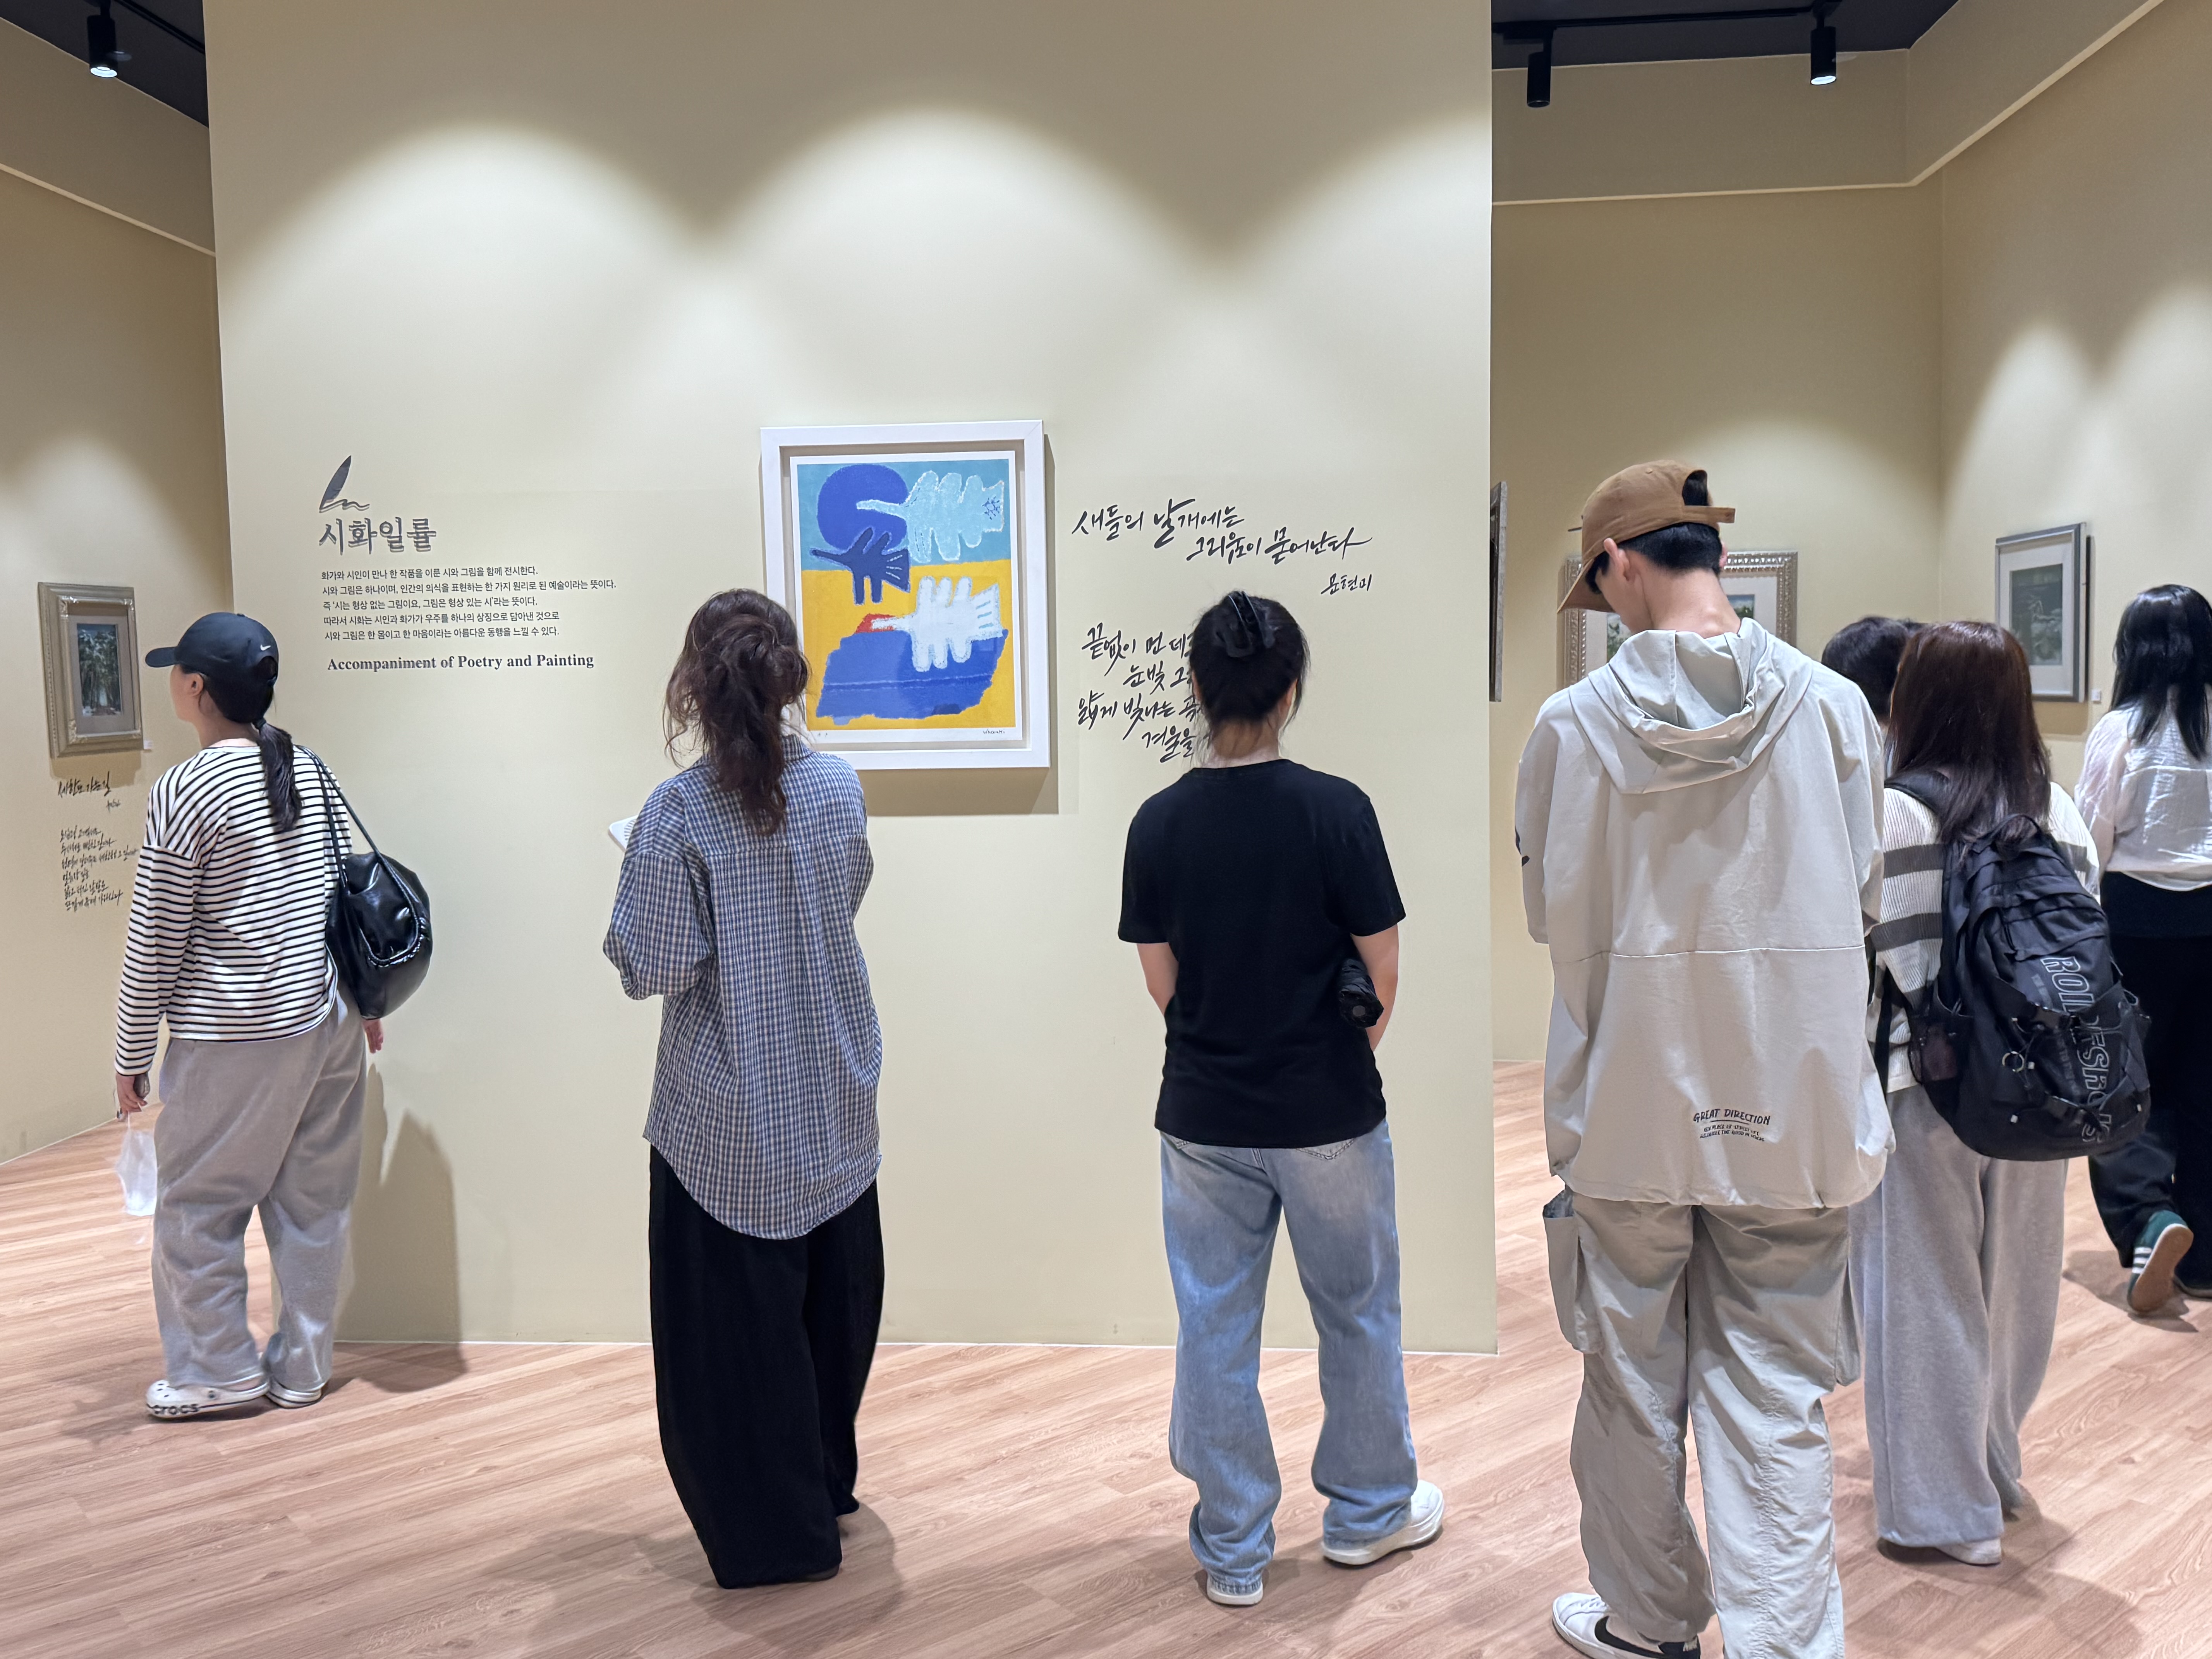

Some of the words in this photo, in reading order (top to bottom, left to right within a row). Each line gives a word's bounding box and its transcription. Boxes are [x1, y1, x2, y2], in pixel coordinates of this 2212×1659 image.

[1072, 505, 1144, 541] 새들의
[1154, 498, 1245, 549] 날개에는
[319, 517, 437, 555] 시화일률
[1186, 532, 1262, 564] 그리움이
[321, 571, 344, 580] 화가와
[347, 570, 369, 580] 시인이
[372, 570, 387, 579] 만나
[390, 570, 397, 579] 한
[400, 569, 422, 579] 작품을
[425, 568, 440, 578] 이룬
[443, 568, 459, 577] 시와
[461, 567, 484, 577] 그림을
[486, 567, 502, 576] 함께
[505, 566, 538, 575] 전시한다.
[323, 586, 338, 596] 시와
[340, 586, 363, 595] 그림은
[365, 584, 398, 594] 하나이며,
[400, 584, 423, 593] 인간의
[426, 583, 449, 593] 의식을
[452, 583, 483, 592] 표현하는
[485, 582, 493, 591] 한
[495, 582, 510, 591] 가지
[513, 582, 537, 591] 원리로
[539, 581, 546, 590] 된
[549, 580, 588, 590] 예술이라는
[590, 579, 616, 589] 뜻이다.
[323, 602, 331, 611] 즉
[352, 601, 368, 610] 형상
[370, 600, 385, 610] 없는
[387, 599, 420, 609] 그림이요,
[423, 599, 446, 608] 그림은
[448, 598, 464, 608] 형상
[466, 598, 482, 607] 있는
[512, 596, 537, 606] 뜻이다.
[324, 616, 347, 625] 따라서
[349, 616, 372, 625] 시화는
[374, 615, 397, 624] 시인과
[400, 614, 423, 624] 화가가
[425, 614, 448, 623] 우주를
[451, 613, 474, 623] 하나의
[477, 613, 508, 622] 상징으로
[510, 612, 534, 621] 담아낸
[536, 611, 560, 621] 것으로
[325, 632, 340, 641] 시와
[343, 631, 365, 640] 그림은
[368, 631, 375, 639] 한
[377, 630, 401, 639] 몸이고
[403, 630, 410, 639] 한
[413, 629, 452, 638] 마음이라는
[454, 628, 485, 637] 아름다운
[488, 627, 510, 637] 동행을
[513, 627, 529, 636] 느낄
[531, 627, 539, 636] 수
[541, 626, 559, 635] 있다.
[1082, 622, 1137, 677] 끝없이
[1146, 631, 1166, 655] 먼
[1169, 632, 1193, 659] 데
[328, 657, 436, 672] Accompaniment
[441, 656, 454, 668] of
[458, 656, 502, 670] Poetry
[507, 655, 532, 666] and
[537, 654, 594, 668] Painting
[1123, 660, 1165, 696] 눈빛
[1123, 692, 1176, 741] 빛나는
[1142, 725, 1196, 763] 겨울을
[1693, 1108, 1721, 1123] GREAT
[1724, 1109, 1771, 1125] DIRECTION
[153, 1403, 199, 1415] crocs
